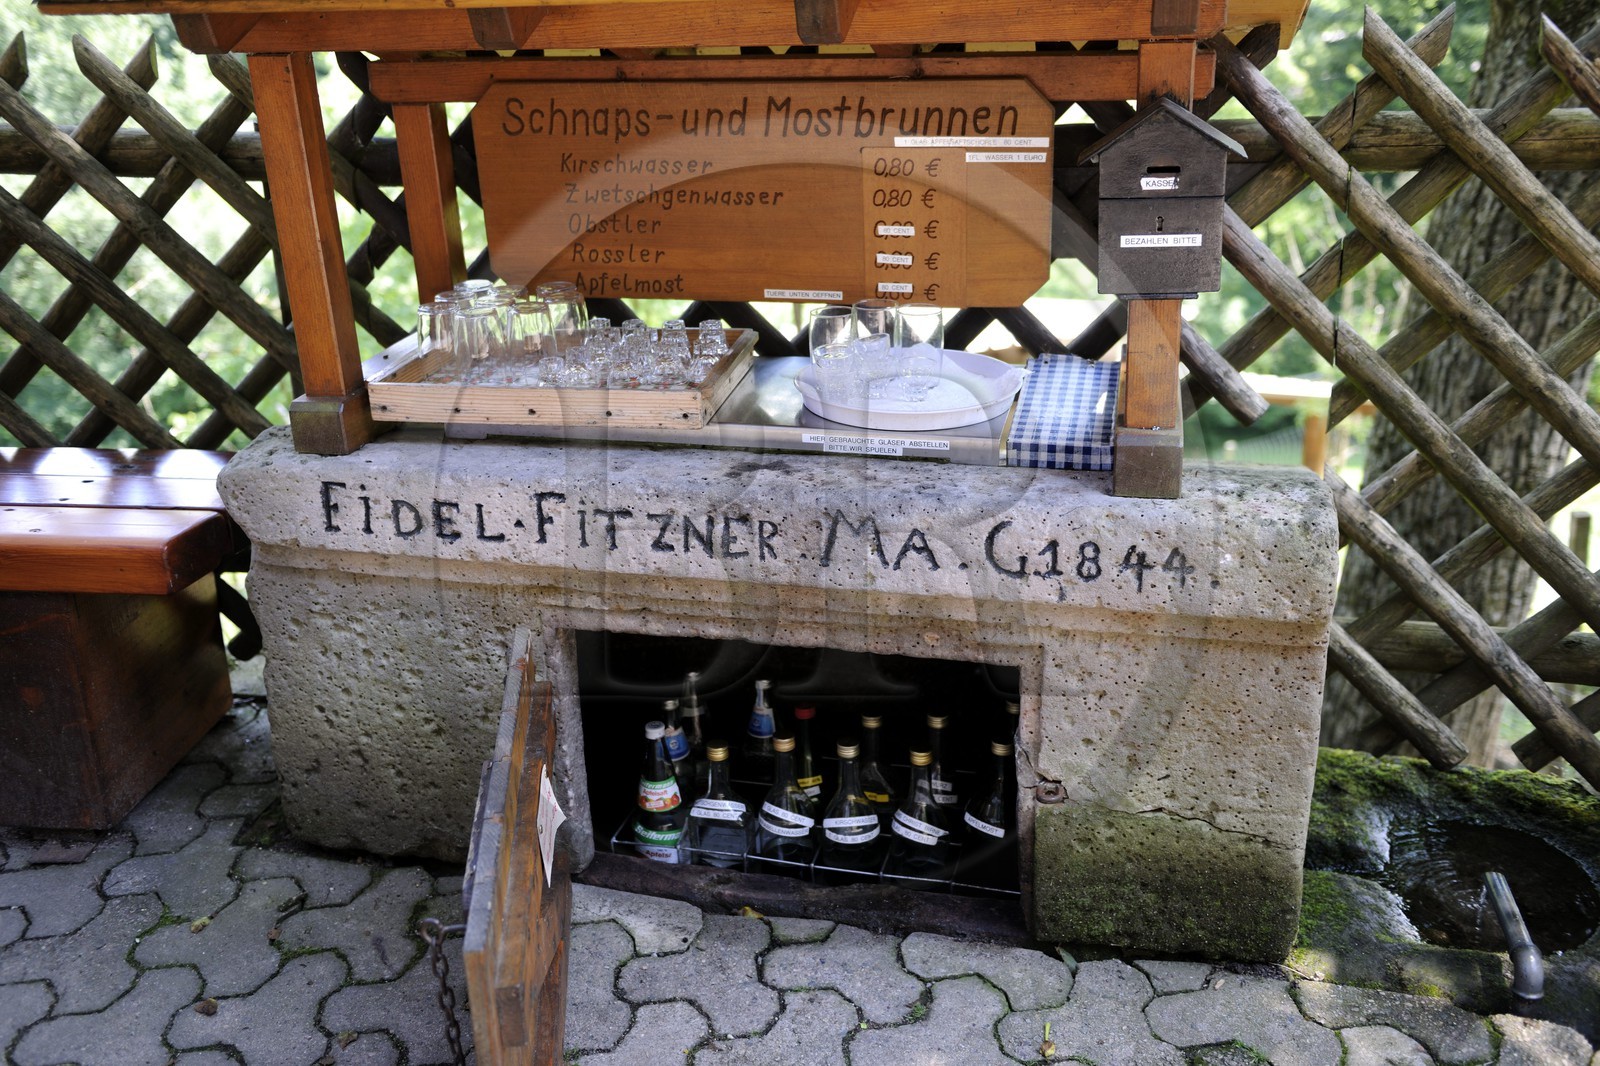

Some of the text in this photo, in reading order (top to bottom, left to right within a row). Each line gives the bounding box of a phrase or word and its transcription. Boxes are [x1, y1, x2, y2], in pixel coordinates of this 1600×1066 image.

[763, 96, 1019, 138] Mostbrunnen
[1014, 139, 1033, 147] CENT
[560, 152, 713, 175] Kirschwasser
[873, 158, 915, 178] 0,80
[985, 154, 1013, 162] WASSER
[1024, 154, 1044, 162] EURO
[872, 188, 912, 208] 0,80
[567, 212, 662, 235] Obstler
[1124, 236, 1197, 246] BEZAHLEN BITTE
[571, 241, 666, 264] Rossler
[575, 270, 684, 296] Apfelmost
[766, 290, 842, 300] TUERE UNTEN OEFFNEN
[828, 436, 875, 445] GEBRAUCHTE
[908, 441, 949, 449] ABSTELLEN
[865, 446, 898, 454] SPUELEN
